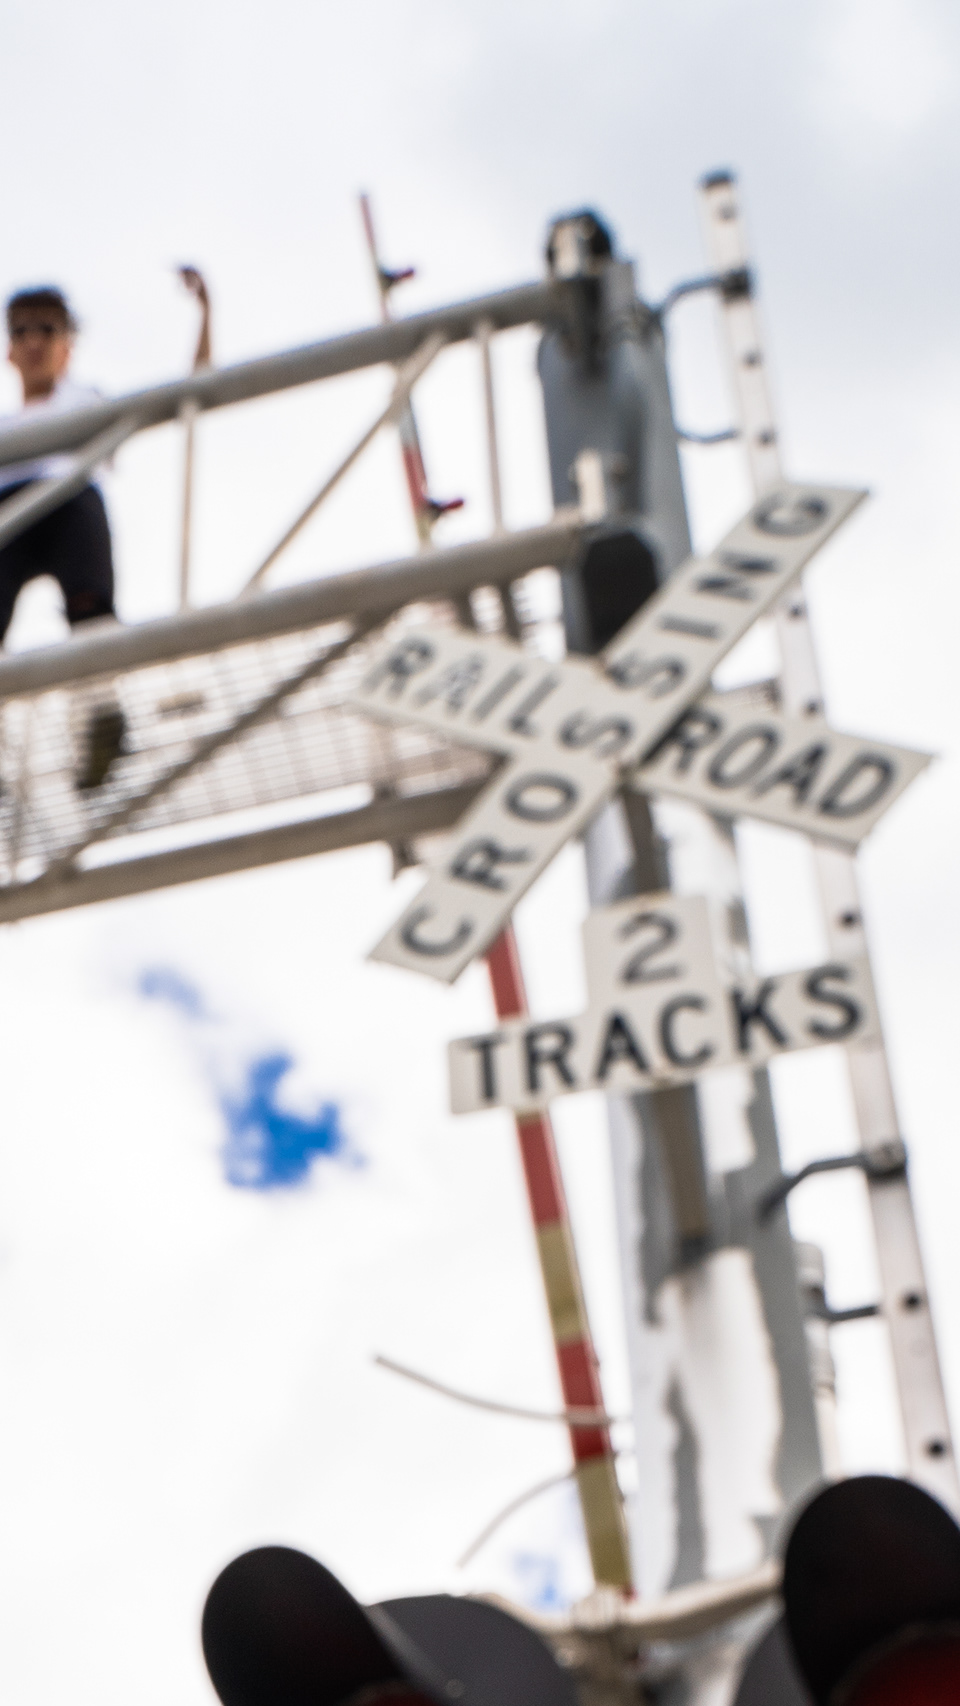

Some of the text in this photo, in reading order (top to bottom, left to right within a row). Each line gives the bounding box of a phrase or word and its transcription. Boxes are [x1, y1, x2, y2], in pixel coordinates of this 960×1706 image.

[397, 492, 830, 960] CROSSING
[619, 912, 680, 988] 2
[468, 963, 864, 1103] TRACKS
